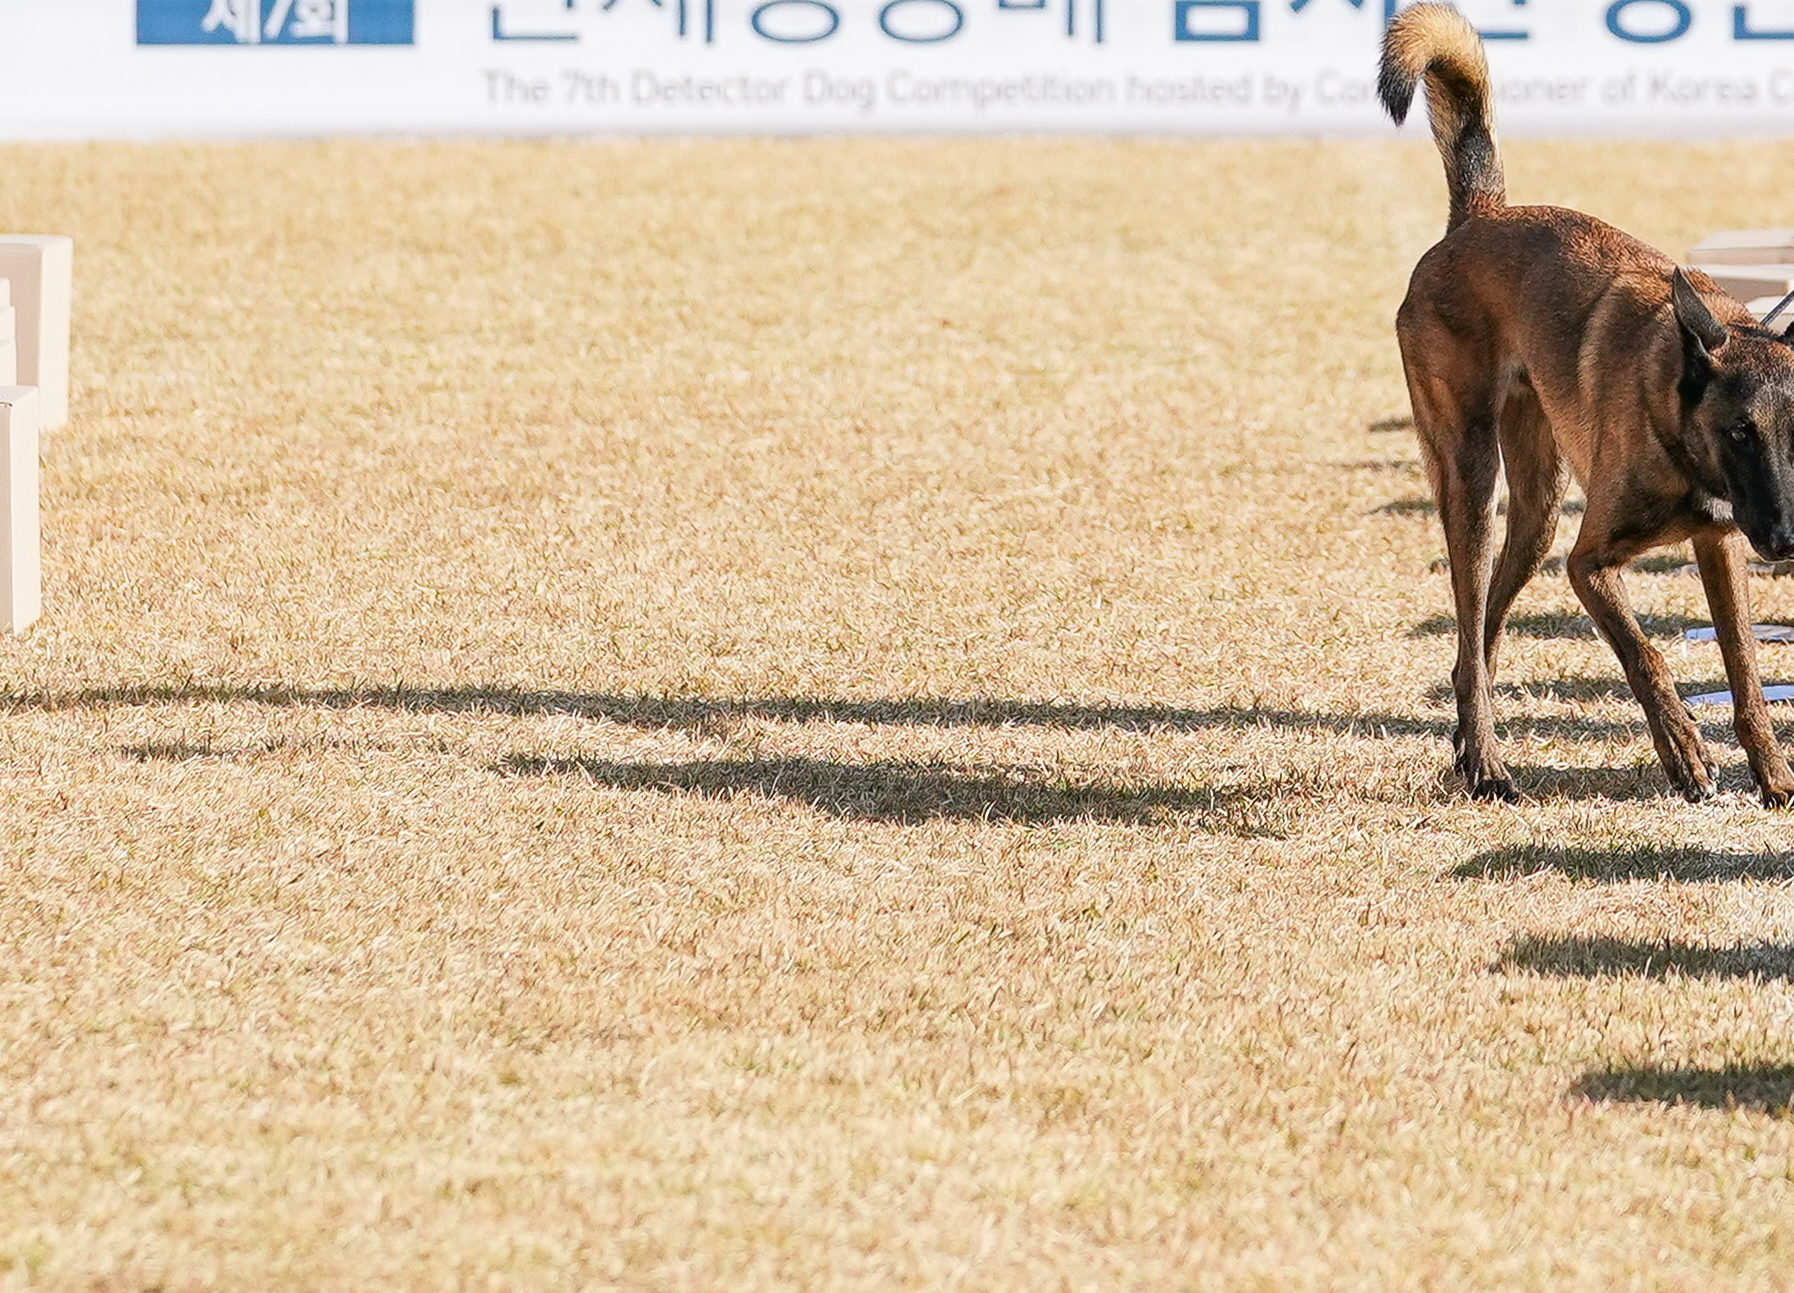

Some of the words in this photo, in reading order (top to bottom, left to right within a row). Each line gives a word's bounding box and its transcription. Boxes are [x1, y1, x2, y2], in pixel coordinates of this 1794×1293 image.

[483, 68, 551, 107] The
[559, 68, 623, 107] 7th
[629, 68, 789, 107] Detector
[804, 69, 877, 116] Dog
[886, 68, 1117, 116] Competition
[1124, 69, 1254, 106] hosted
[1262, 70, 1302, 115] by
[1601, 69, 1641, 107] of
[1648, 69, 1760, 107] Korea
